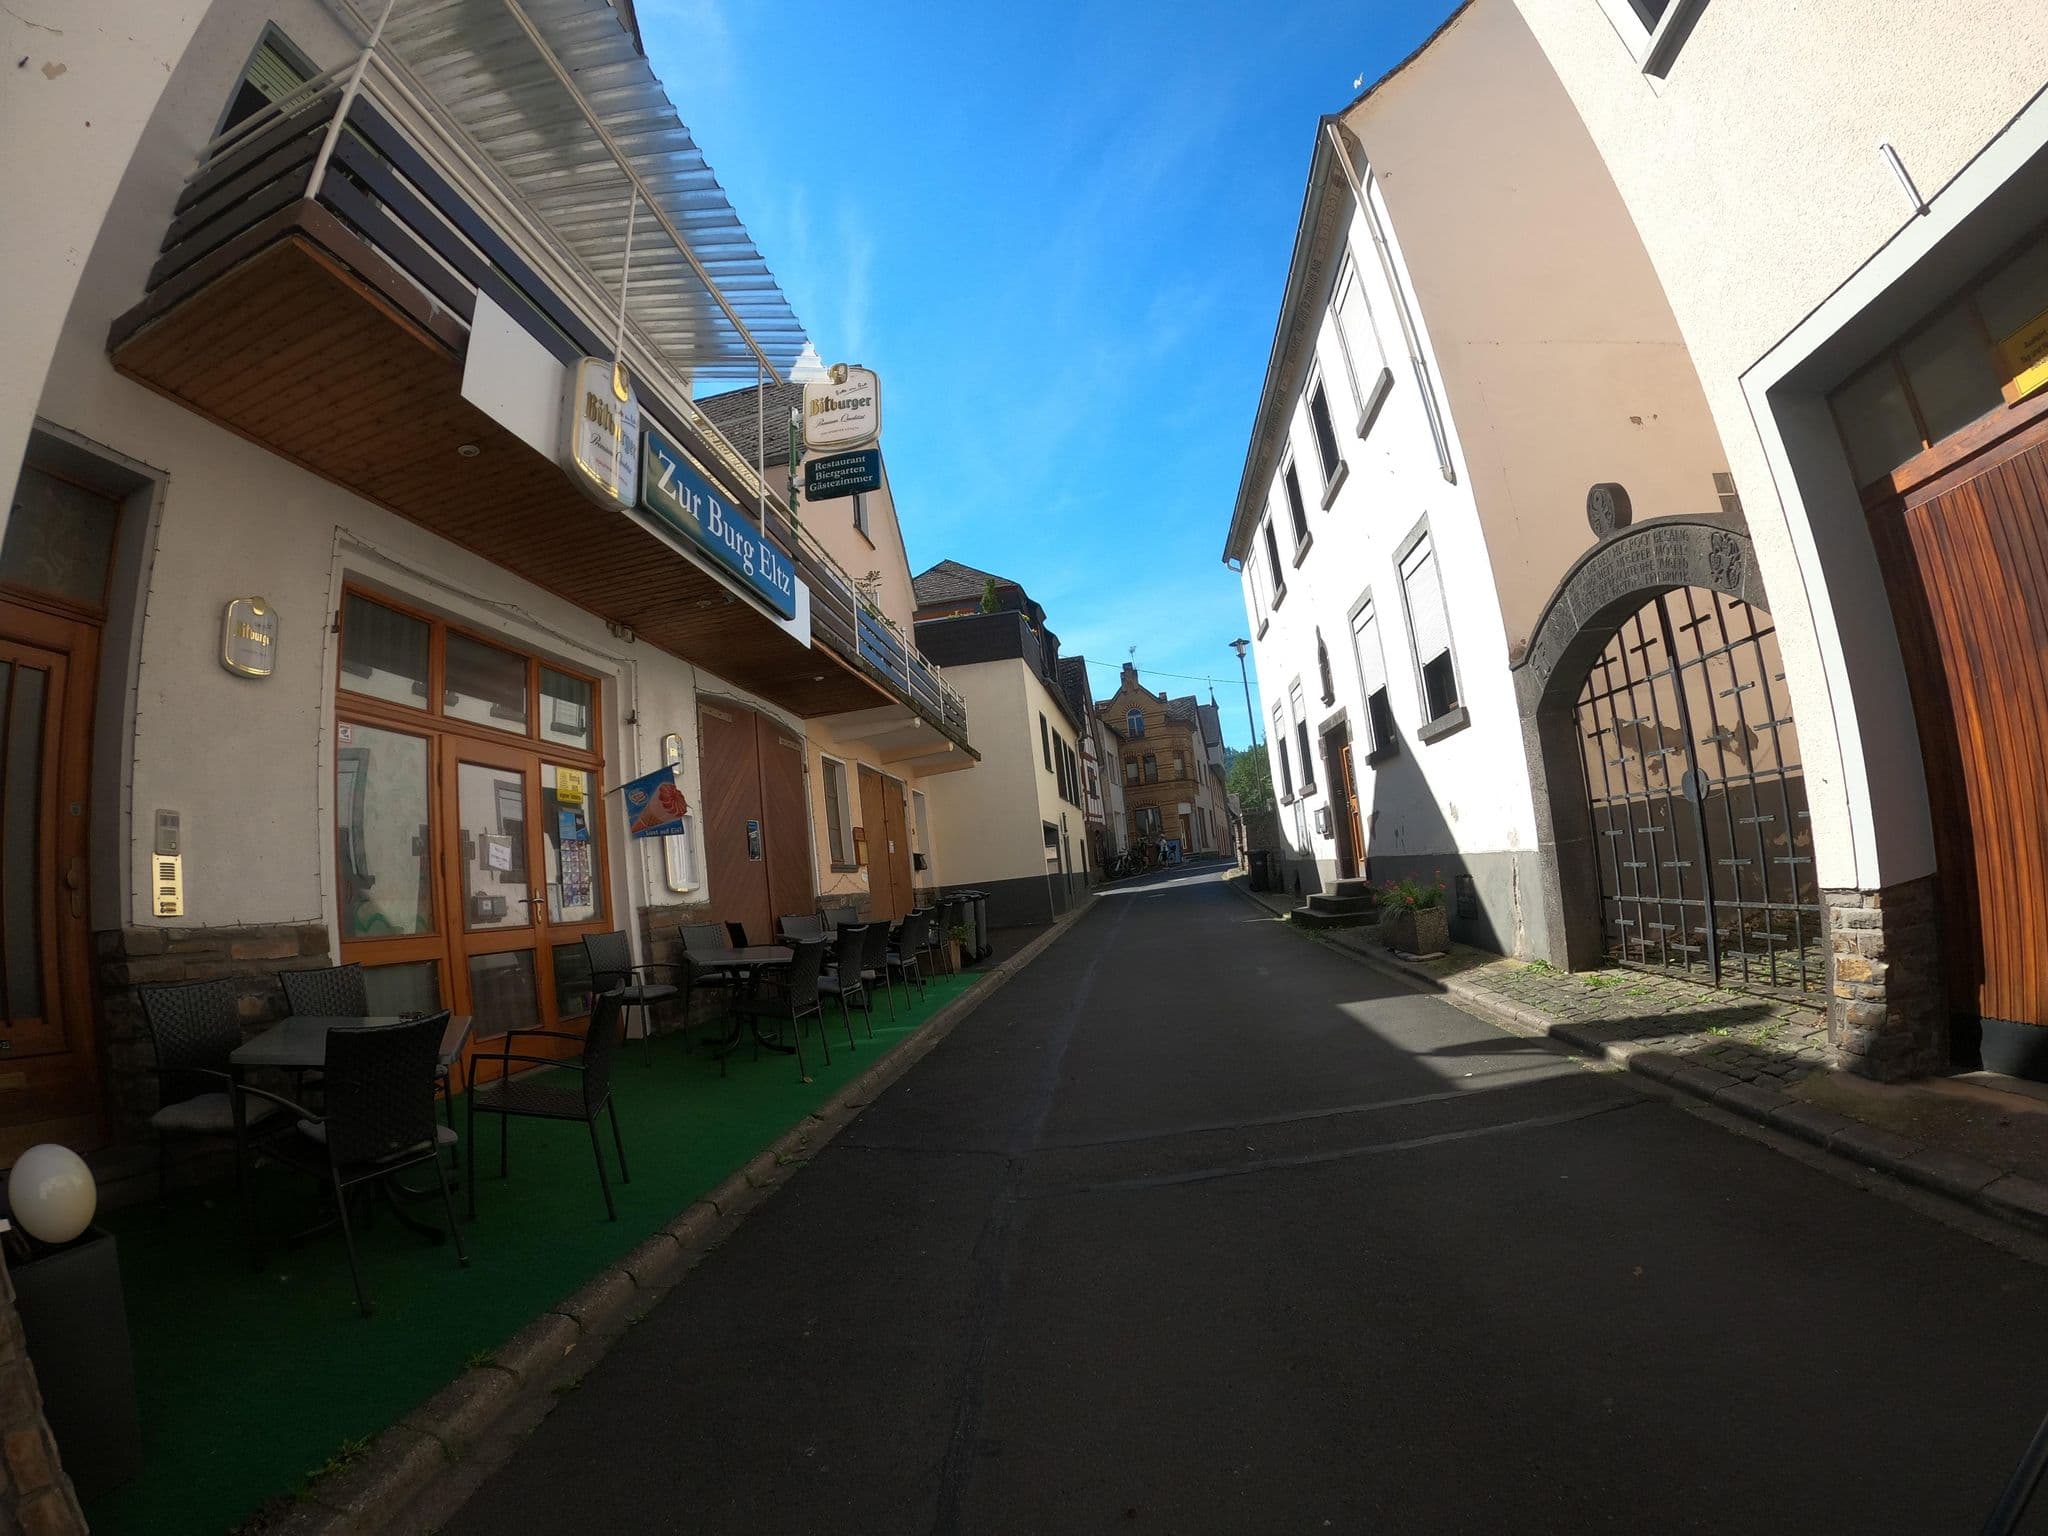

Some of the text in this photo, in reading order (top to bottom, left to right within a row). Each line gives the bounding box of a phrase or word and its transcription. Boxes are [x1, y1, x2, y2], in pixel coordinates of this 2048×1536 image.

[809, 395, 872, 417] Bitburger
[815, 455, 866, 471] Restaurant
[815, 466, 866, 481] Biergarten
[809, 475, 873, 492] Gästezimmer
[658, 449, 791, 597] Zur Burg Eltz
